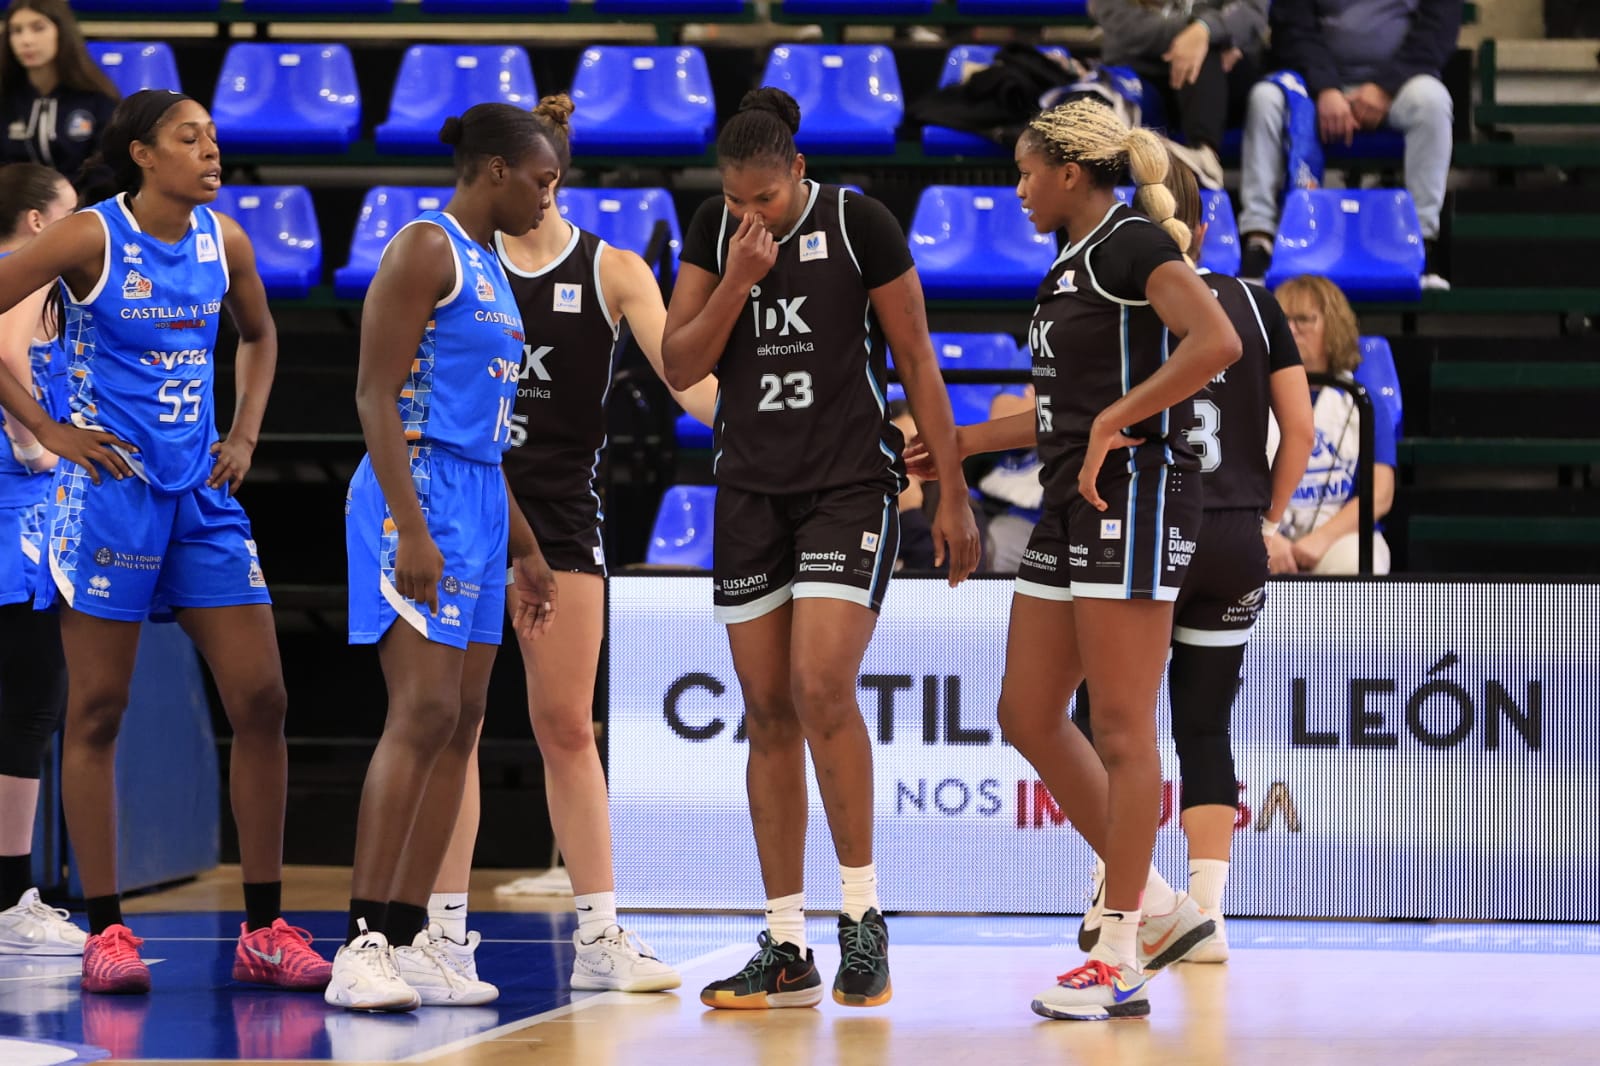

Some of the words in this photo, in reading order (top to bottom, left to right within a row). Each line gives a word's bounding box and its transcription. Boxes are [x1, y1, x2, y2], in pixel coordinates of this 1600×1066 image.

[120, 306, 186, 319] CASTILLA
[190, 305, 199, 318] Y
[757, 371, 815, 412] 23
[158, 378, 202, 424] 55
[1169, 526, 1182, 539] EL
[1168, 539, 1197, 554] DIARIO
[801, 550, 847, 561] Donostia
[722, 573, 768, 590] EUSKADI
[1291, 652, 1542, 752] LEÓN
[897, 778, 1002, 816] NOS
